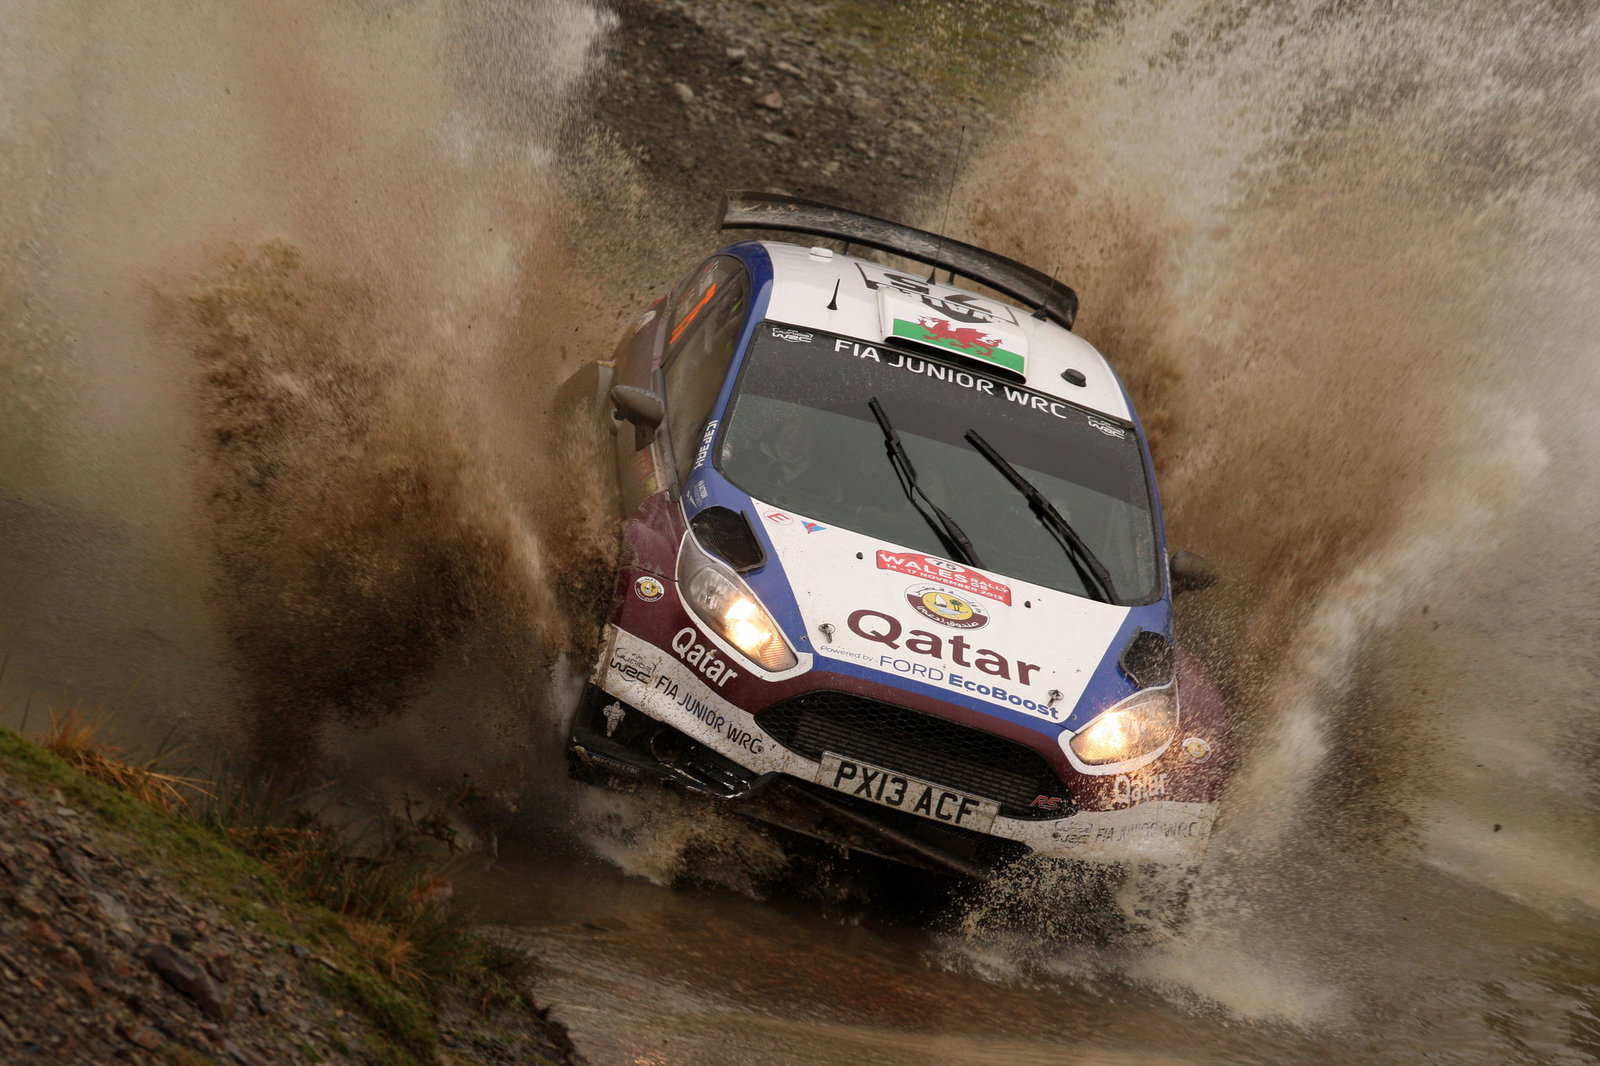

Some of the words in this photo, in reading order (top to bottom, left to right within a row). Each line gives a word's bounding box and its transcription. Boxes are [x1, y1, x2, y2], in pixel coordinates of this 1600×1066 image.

[834, 339, 880, 362] FIA
[888, 355, 994, 396] JUNIOR
[1003, 386, 1067, 419] WRC
[880, 553, 968, 584] WALES
[970, 577, 1009, 593] RALLY
[920, 573, 978, 592] NOVEMBER
[936, 561, 957, 570] 75
[971, 583, 989, 591] GB
[671, 627, 738, 688] Qatar
[847, 609, 1041, 686] Qatar
[820, 645, 861, 659] Powered
[862, 653, 874, 662] by
[879, 655, 944, 681] FORD
[949, 673, 1059, 720] EcoBoost
[655, 675, 680, 700] FIA
[677, 693, 725, 733] JUNIOR
[727, 724, 764, 754] WRC
[833, 760, 908, 806] PX13
[913, 787, 980, 825] ACF
